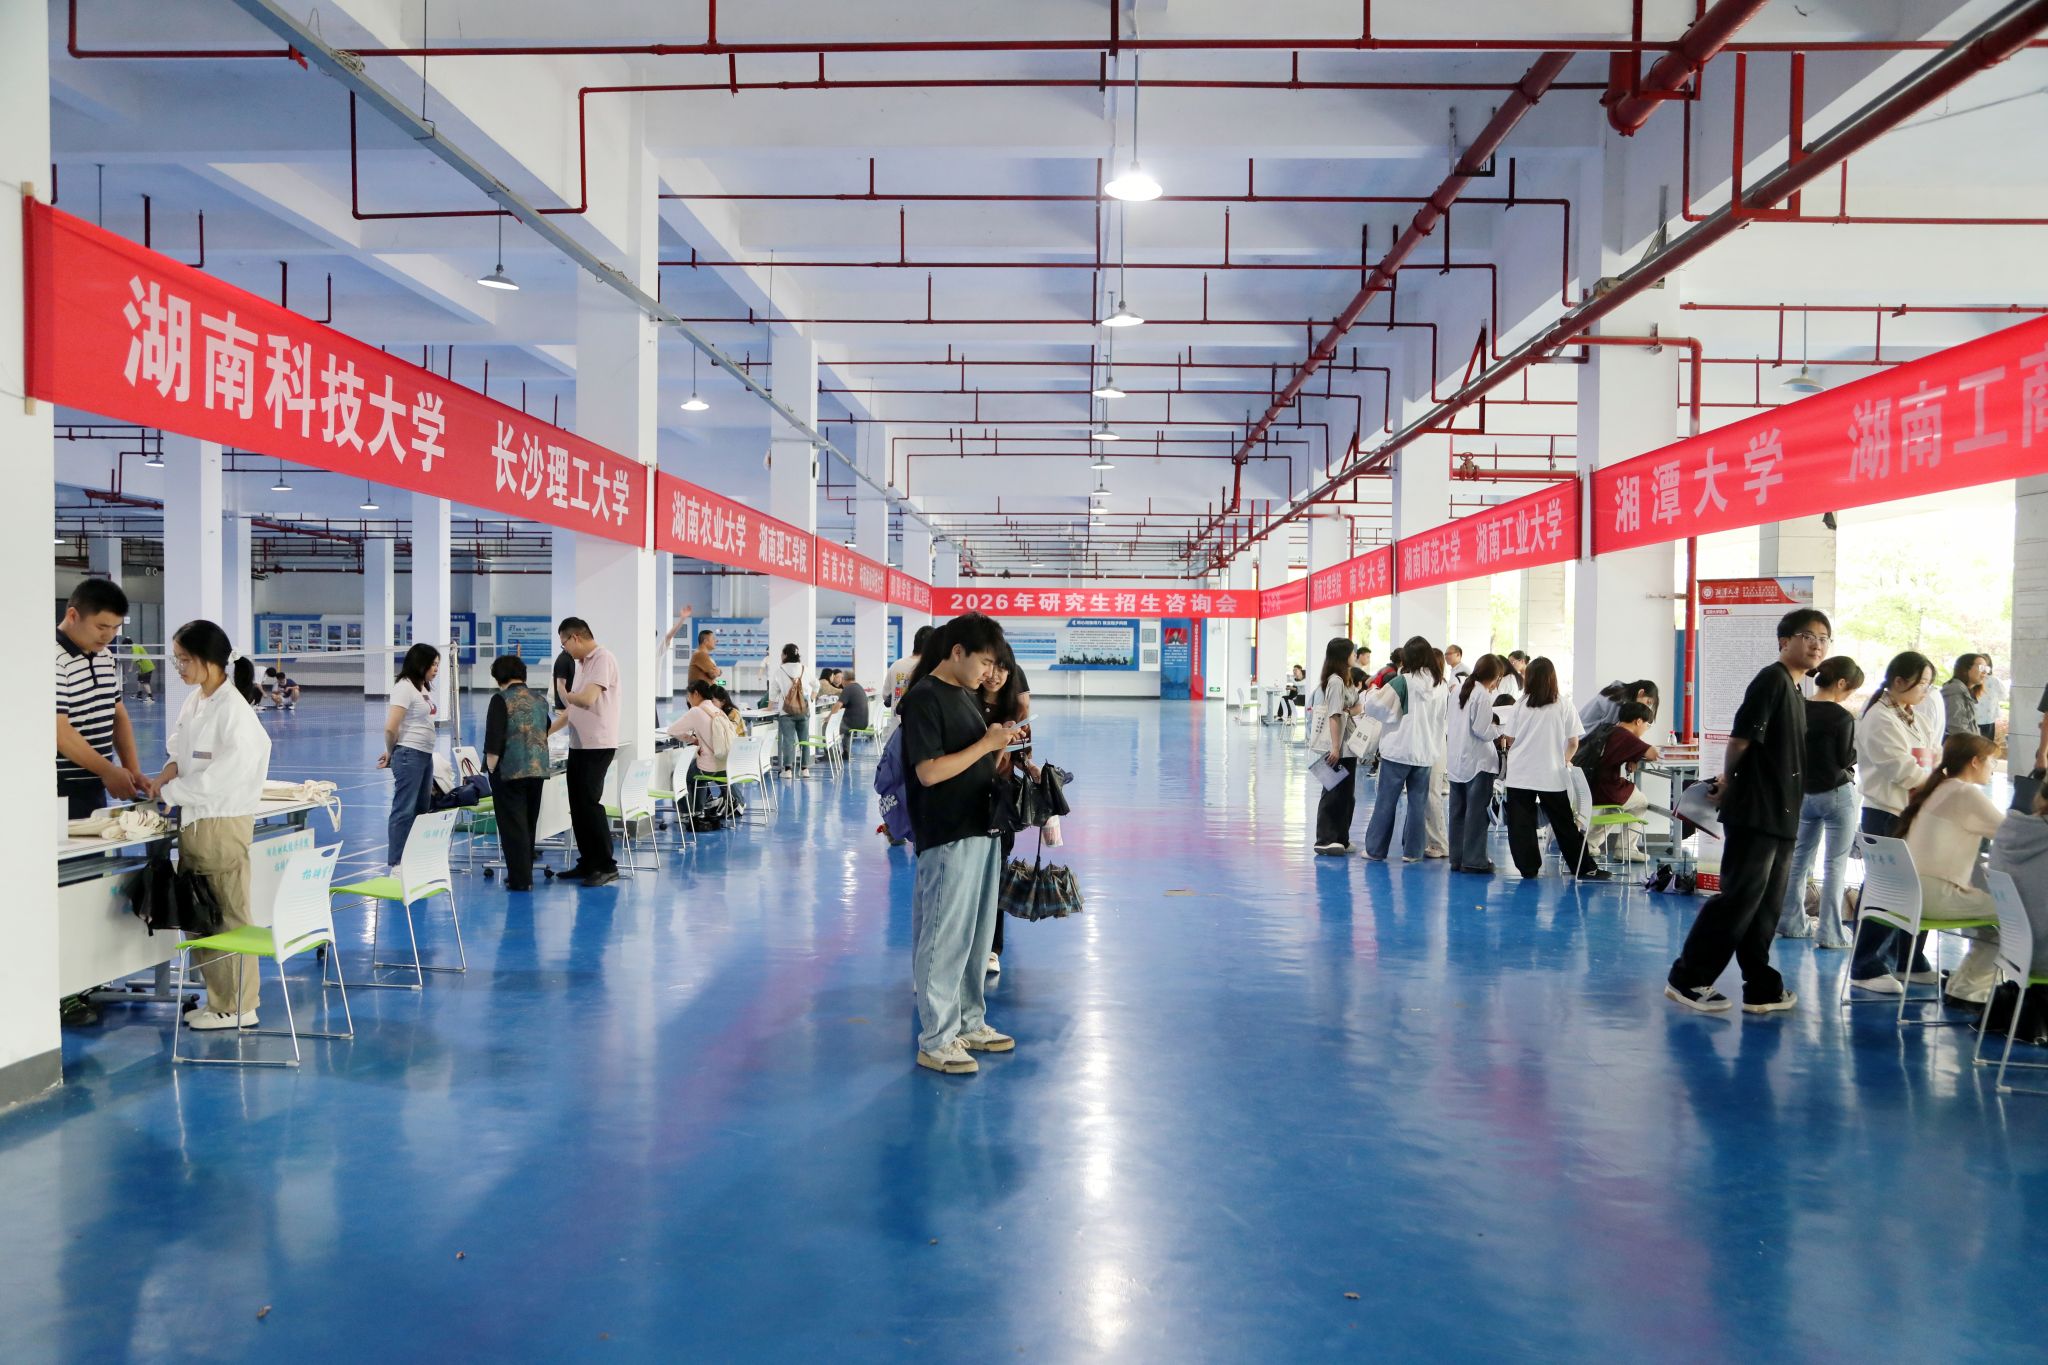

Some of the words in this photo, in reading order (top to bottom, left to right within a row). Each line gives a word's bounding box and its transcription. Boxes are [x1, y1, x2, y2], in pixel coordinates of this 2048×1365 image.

[122, 274, 447, 473] 湖南科技大学
[490, 419, 631, 527] 长沙理工大学
[1613, 427, 1785, 534] 湘潭大学
[672, 491, 746, 557] 湖南农业大学
[759, 522, 807, 574] 湖南理工学院
[822, 548, 854, 587] 吉首大学
[1404, 530, 1460, 580] 湖南师范大学
[1476, 499, 1562, 563] 湖南工业大学
[950, 592, 1239, 615] 2026年研究生招生咨询会
[1349, 555, 1387, 597] 南华大学
